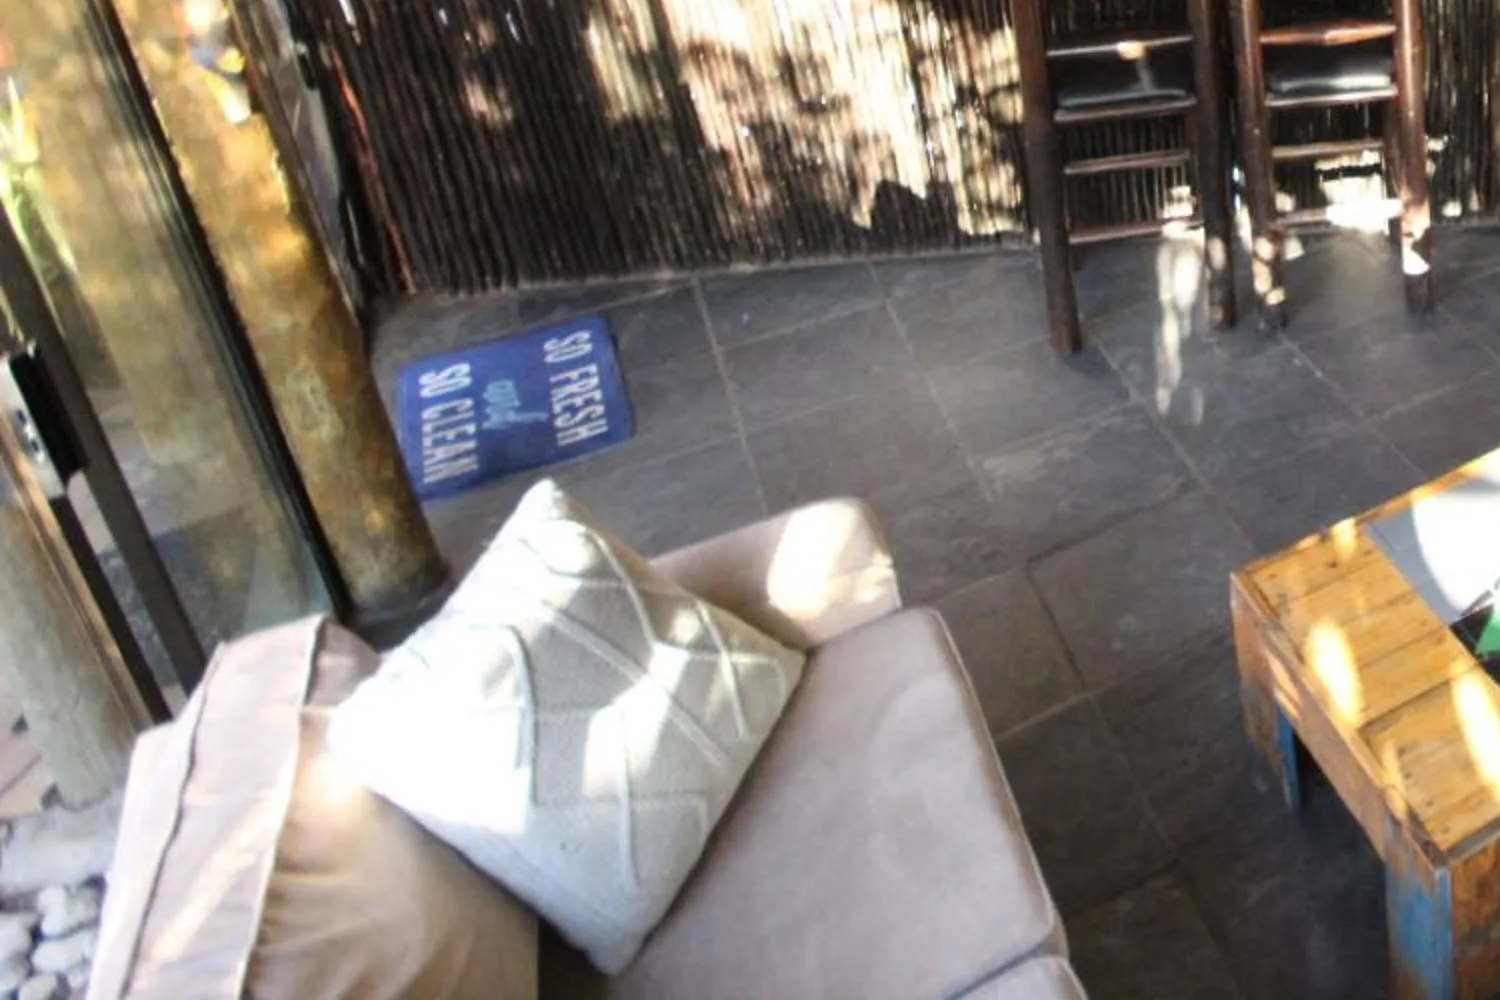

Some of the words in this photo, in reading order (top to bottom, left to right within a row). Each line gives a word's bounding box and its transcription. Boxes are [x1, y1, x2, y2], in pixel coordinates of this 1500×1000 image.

[542, 330, 594, 363] SO
[419, 362, 473, 398] SO
[549, 363, 609, 447] FRESH
[421, 398, 479, 484] CLEAN
